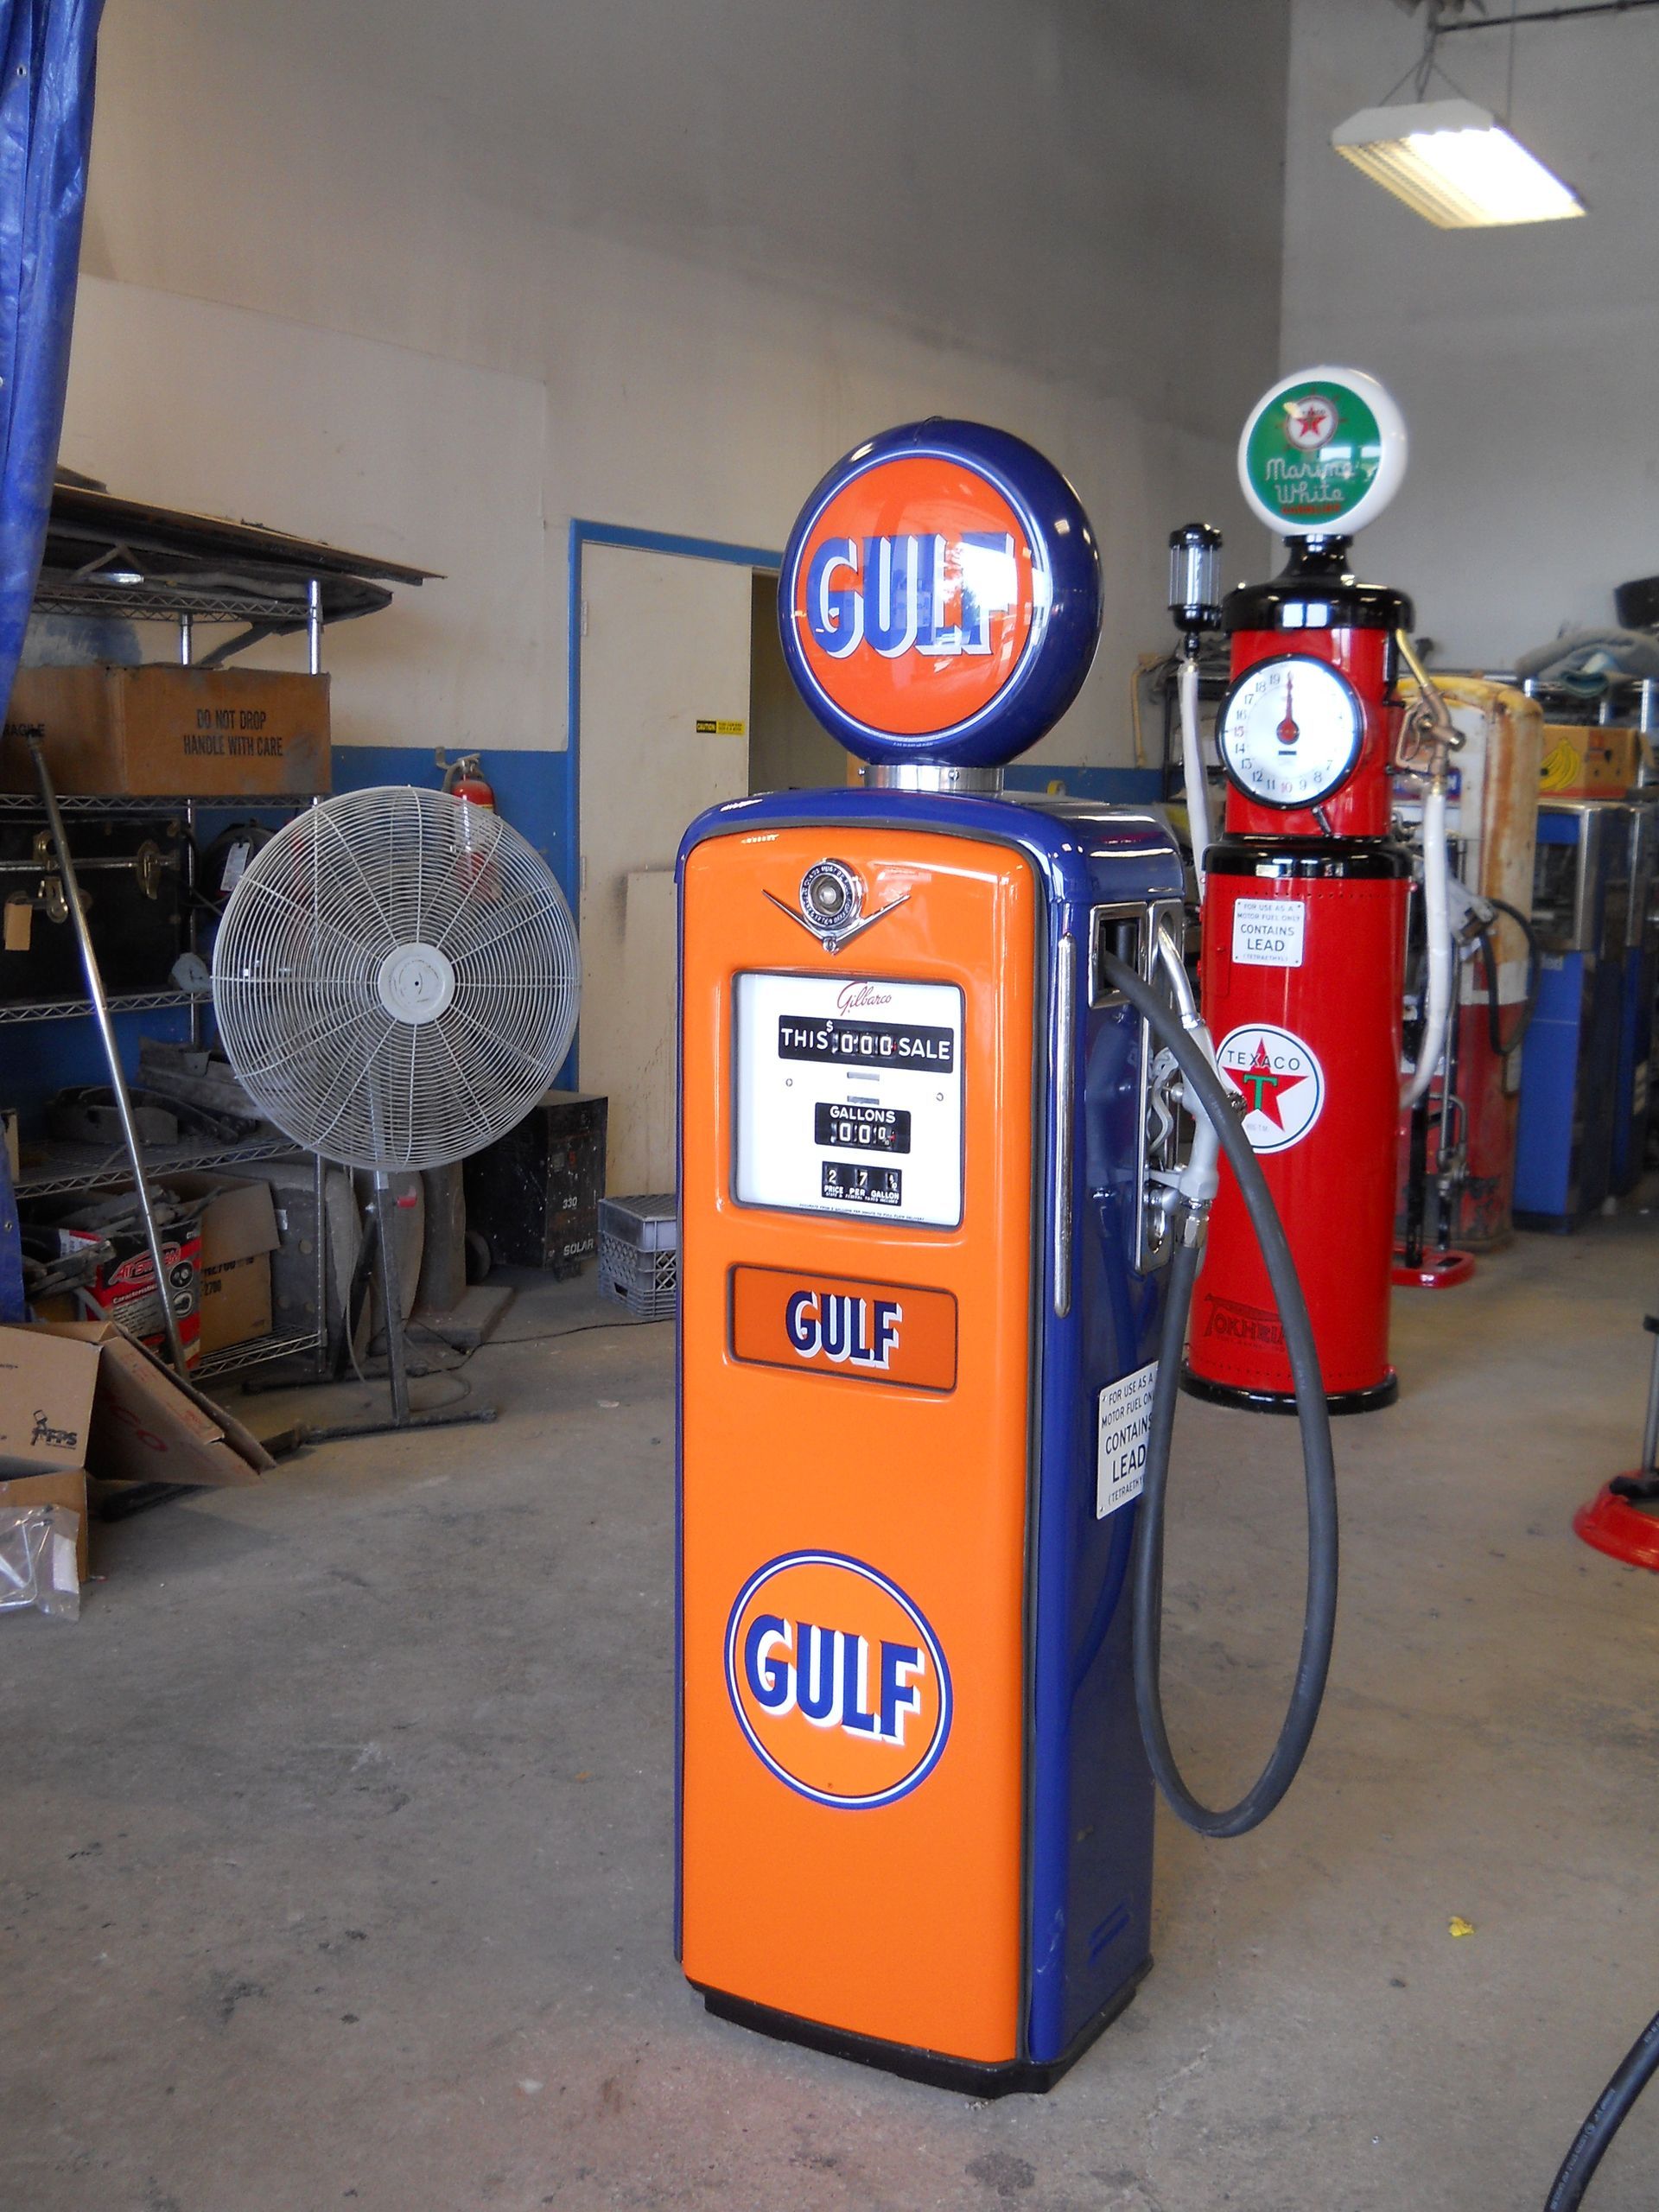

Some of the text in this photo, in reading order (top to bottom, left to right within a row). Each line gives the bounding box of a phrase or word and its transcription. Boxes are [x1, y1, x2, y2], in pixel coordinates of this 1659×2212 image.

[1275, 479, 1344, 503] White
[805, 531, 1015, 659] GULF
[1255, 682, 1267, 692] 18
[1269, 673, 1281, 684] 19
[1244, 694, 1254, 704] 17
[196, 709, 267, 730] DO NOT DROP
[183, 734, 283, 757] HANDLE WITH CARE
[1235, 743, 1245, 753] 14
[1253, 771, 1263, 782] 12
[1267, 779, 1275, 790] 11
[1313, 772, 1322, 783] 8
[1241, 924, 1294, 936] CONTAINS
[1247, 938, 1285, 951] LEAD
[836, 981, 893, 1017] Gilbarco
[781, 1027, 829, 1050] THIS
[898, 1037, 951, 1060] SALE
[1227, 1050, 1300, 1071] TEXACO
[1243, 1073, 1278, 1110] T
[830, 1105, 896, 1123] GALLONS
[823, 1185, 899, 1200] PRICE PER GALLON
[563, 1197, 577, 1210] 330
[563, 1238, 594, 1255] SOLAR
[785, 1290, 903, 1370] GULF
[1109, 1372, 1154, 1406] FOR USE AS A
[1102, 1390, 1154, 1429] MOTOR FUEL ON
[1112, 1444, 1147, 1484] LEAD
[744, 1613, 925, 1746] GULF
